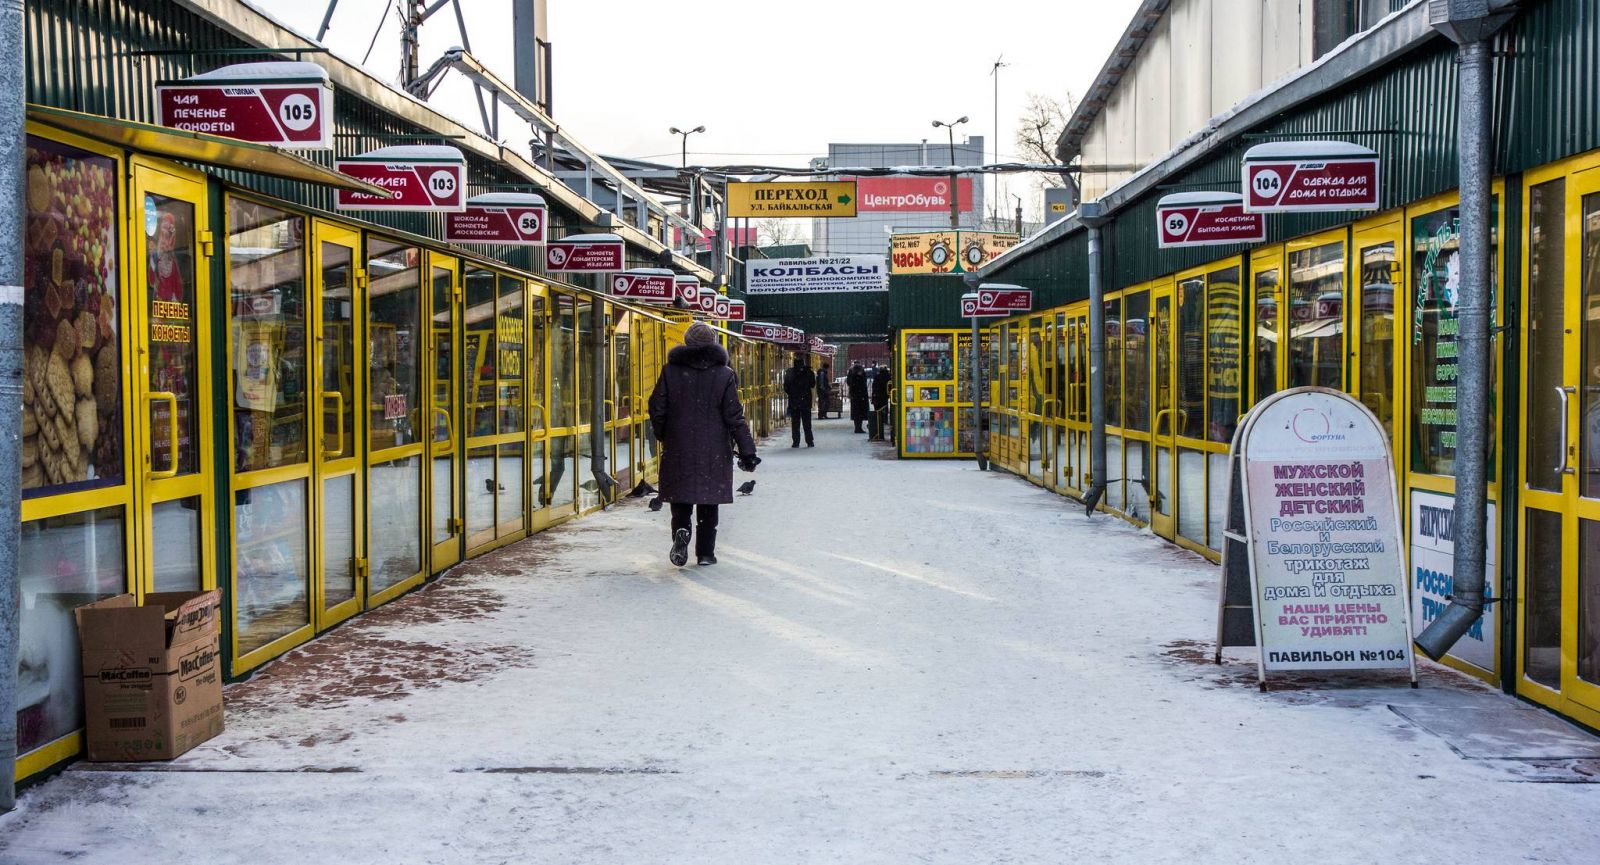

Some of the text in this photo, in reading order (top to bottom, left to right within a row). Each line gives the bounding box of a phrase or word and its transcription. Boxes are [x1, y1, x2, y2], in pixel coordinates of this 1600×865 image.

[173, 95, 198, 104] ЧАЙ
[174, 108, 227, 118] ПЕЧЕНЬЕ
[284, 104, 312, 120] 105
[174, 122, 235, 132] КОНФЕТЫ
[355, 177, 406, 187] АКАЛЕЯ
[432, 178, 454, 191] 103
[1256, 177, 1279, 190] 104
[1303, 176, 1367, 186] ОДЕЖДА ДЛЯ
[755, 188, 829, 201] ПЕРЕХОД
[1289, 187, 1367, 198] ДОМА И ОТДЫХА
[750, 201, 833, 211] УЛ. БАЙКАЛЬСКАЯ
[864, 193, 946, 207] ЦентрОбувь
[522, 219, 537, 229] 58
[1169, 220, 1184, 229] 59
[1214, 215, 1256, 223] КОСМЕТИКА
[1197, 225, 1230, 233] БЫТОВАЯ
[552, 250, 564, 263] 1/2
[753, 265, 878, 277] КОЛБАСЫ
[152, 301, 189, 319] ПЕЧЕНЬЕ
[152, 324, 190, 343] КОНФЕТЫ
[1273, 461, 1365, 480] МУЖСКОЙ
[1275, 479, 1366, 498] ЖЕНСКИЙ
[1279, 496, 1365, 518] ДЕТСКИЙ
[1270, 516, 1378, 533] Российский
[1319, 532, 1330, 543] и
[1267, 538, 1385, 557] Белорусский
[1284, 558, 1370, 574] трикотаж
[1312, 572, 1345, 586] для
[1264, 584, 1397, 601] дома и отдыха
[1283, 602, 1381, 615] НАШИ ЦЕНЫ
[1278, 614, 1388, 626] ВАС ПРИЯТНО
[1300, 625, 1368, 638] УДИВЯТ!
[1268, 649, 1405, 663] ПАВИЛЬОН №104
[180, 651, 214, 677] MacCoffee
[101, 670, 151, 681] MacCoffee
